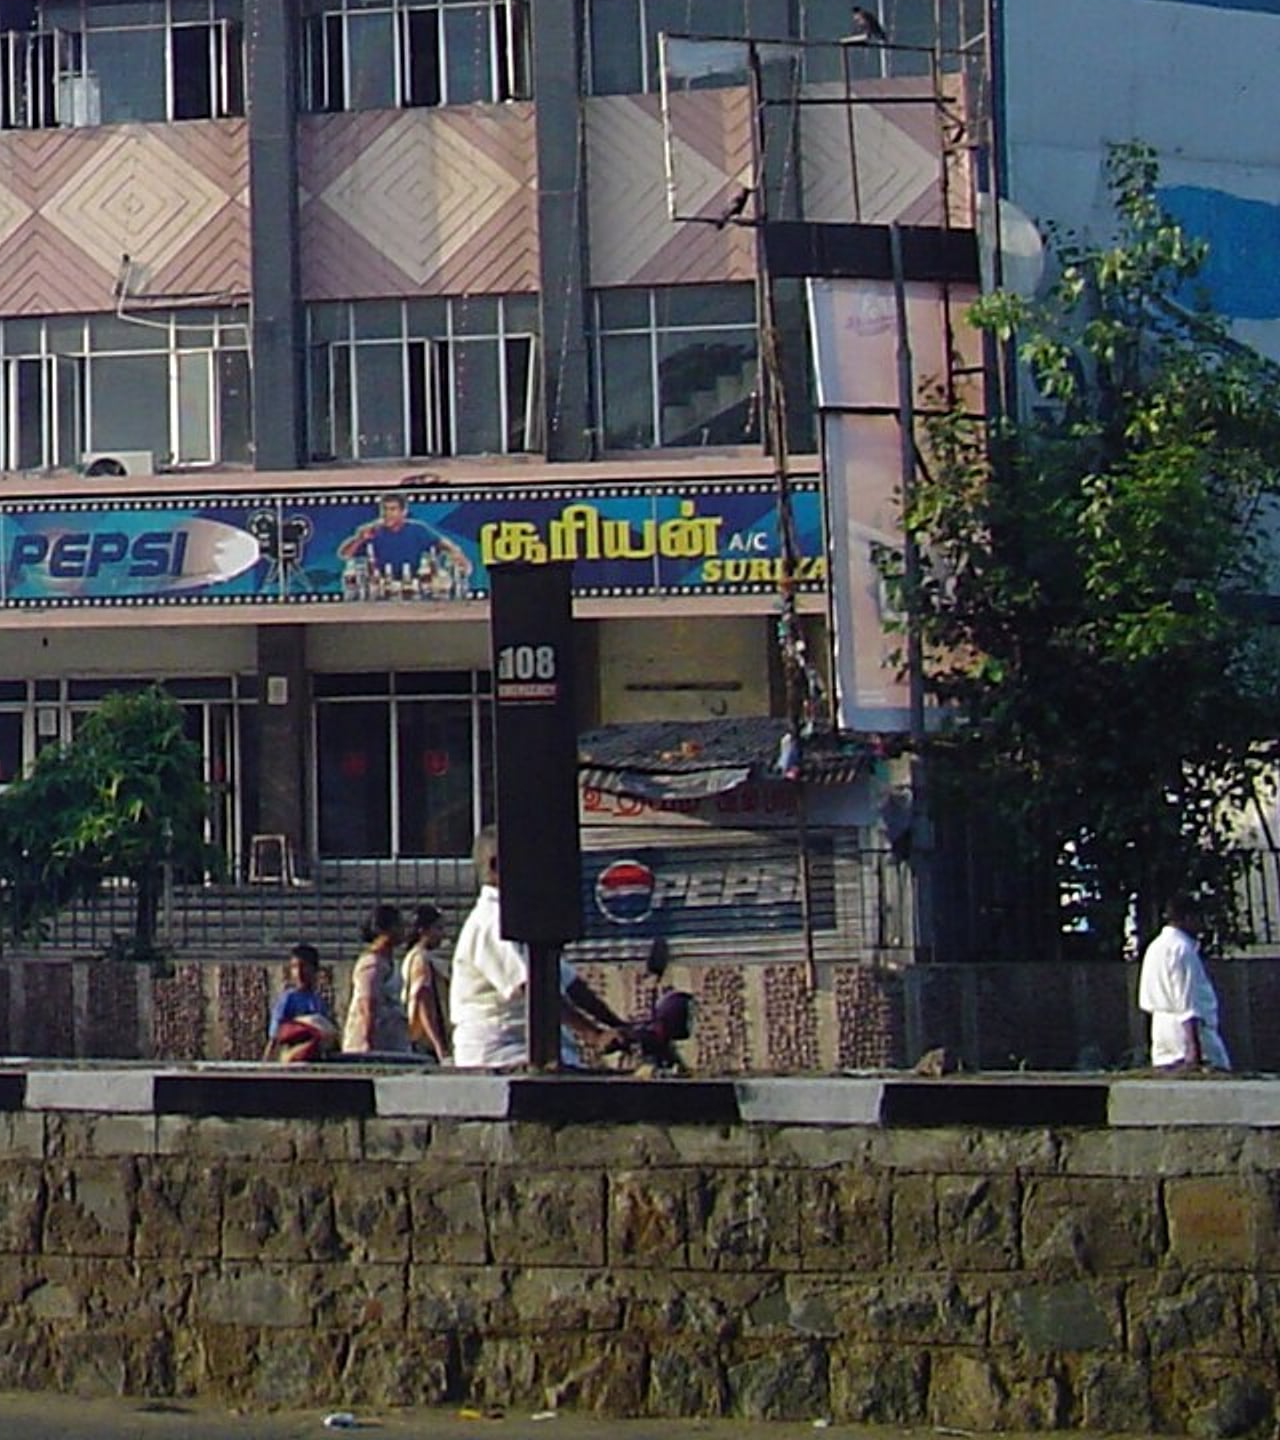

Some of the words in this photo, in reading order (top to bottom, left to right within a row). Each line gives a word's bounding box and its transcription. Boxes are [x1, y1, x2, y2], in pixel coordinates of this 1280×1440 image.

[11, 531, 187, 580] PEPSI
[727, 532, 768, 552] A/C
[498, 645, 556, 679] 108
